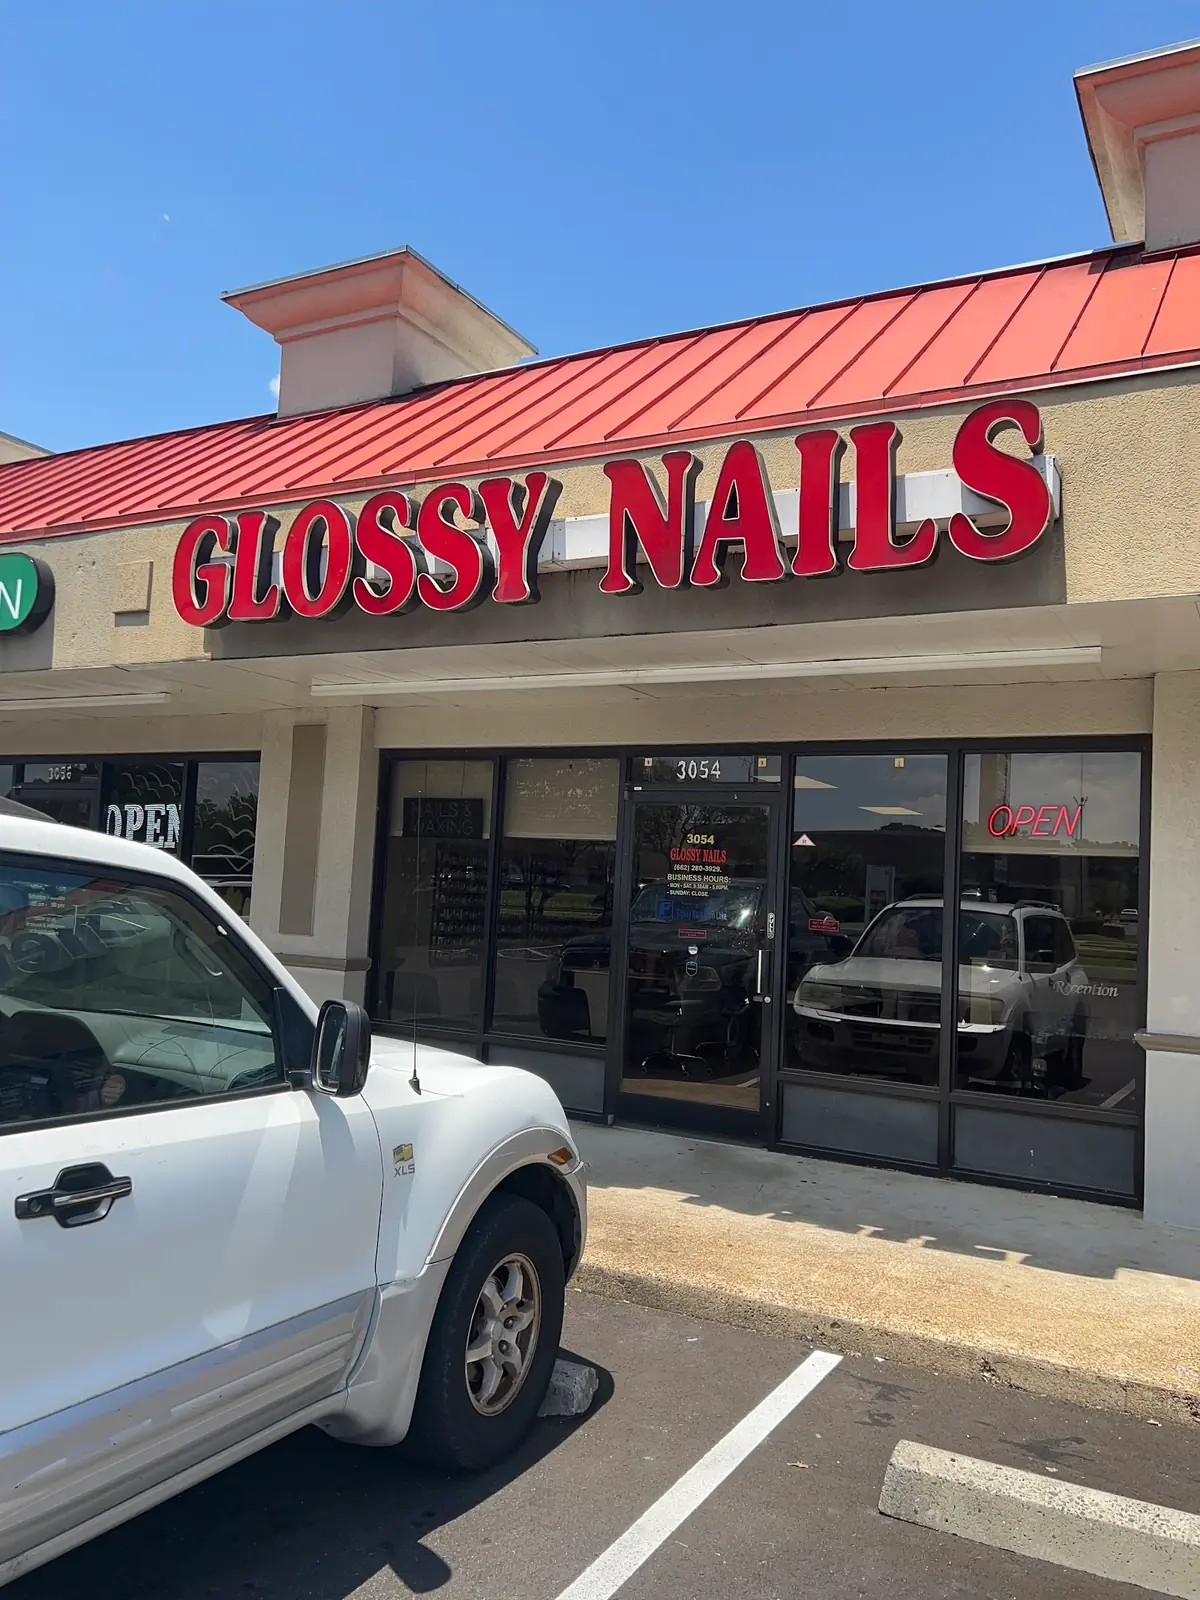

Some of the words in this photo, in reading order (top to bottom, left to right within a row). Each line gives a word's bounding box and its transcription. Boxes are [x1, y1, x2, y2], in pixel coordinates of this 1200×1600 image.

[172, 472, 557, 628] GLOSSY
[599, 399, 1054, 594] NAILS
[676, 760, 721, 780] 3054
[411, 801, 459, 818] NAILS
[106, 803, 181, 849] OPEN
[988, 804, 1082, 837] OPEN
[686, 833, 715, 845] 3054
[670, 847, 701, 861] GLOSSY
[702, 848, 727, 863] NAILS
[667, 873, 702, 882] BUSINESS
[703, 874, 731, 884] HOURS:
[394, 1163, 416, 1178] XLS
